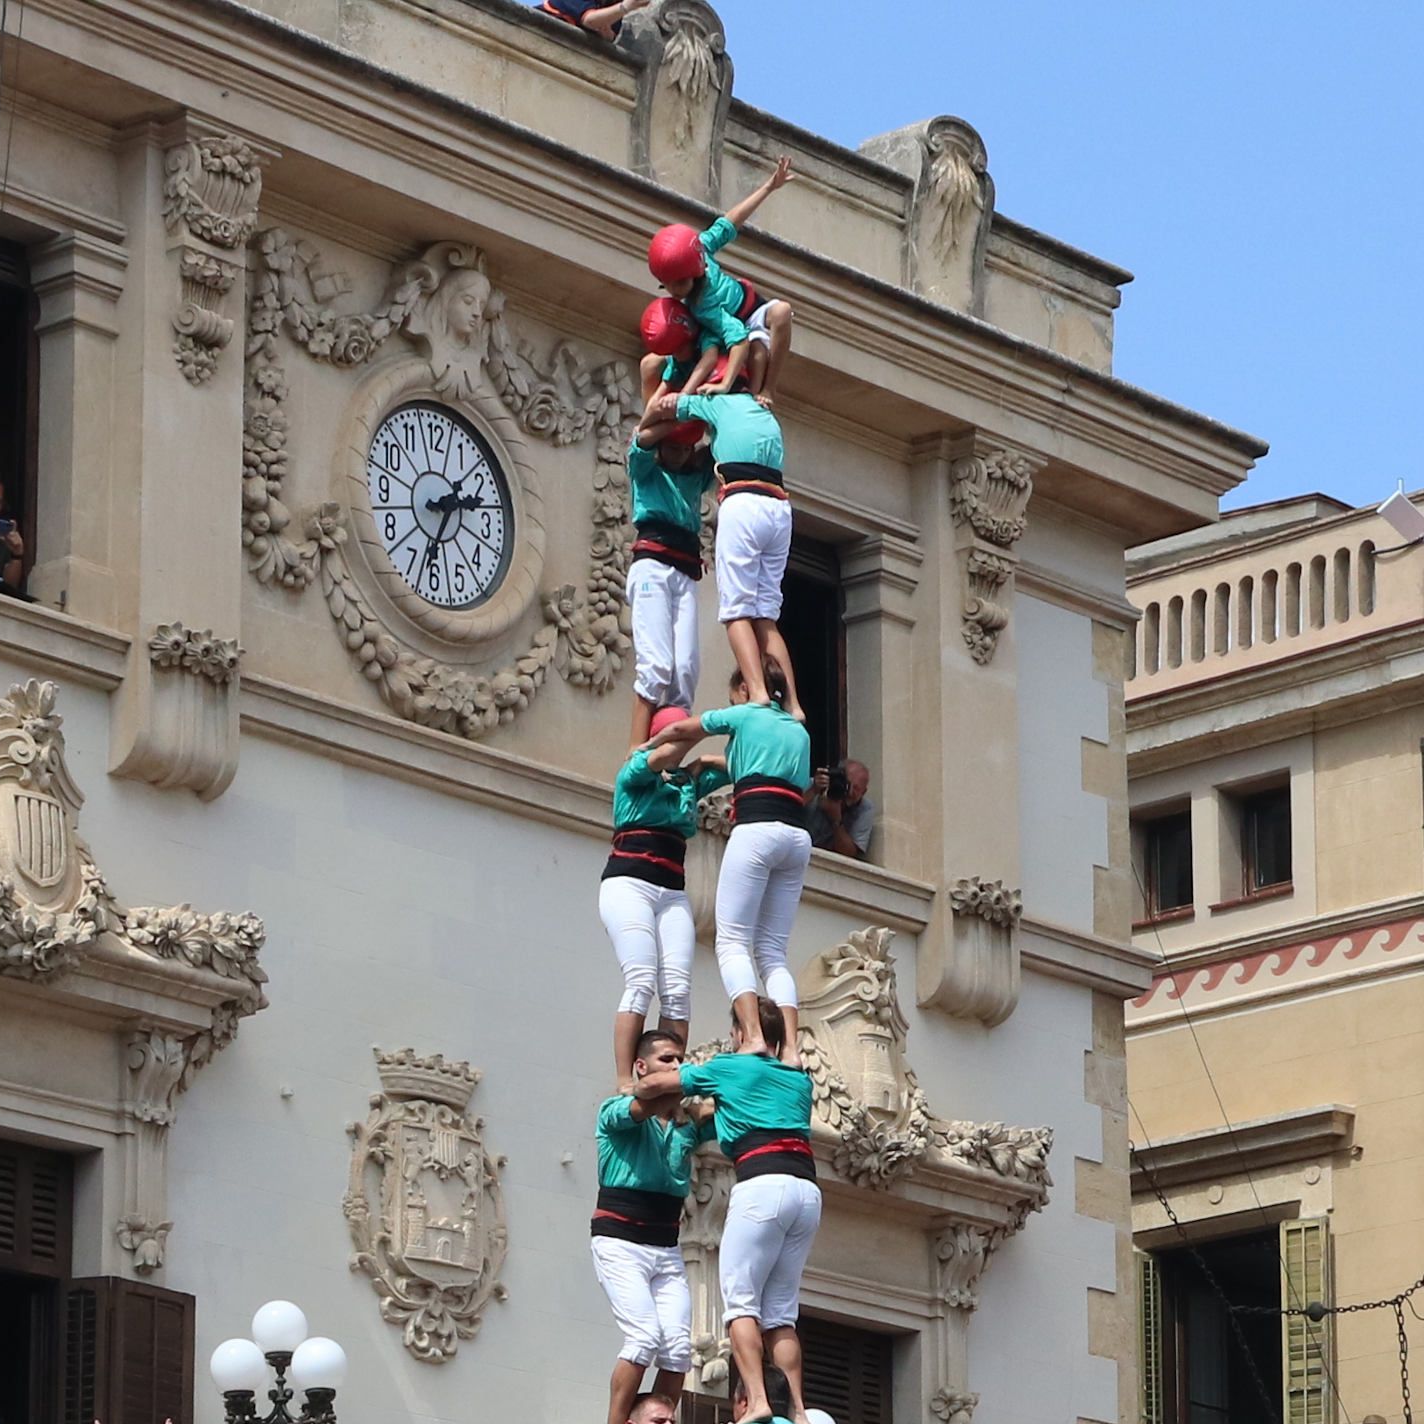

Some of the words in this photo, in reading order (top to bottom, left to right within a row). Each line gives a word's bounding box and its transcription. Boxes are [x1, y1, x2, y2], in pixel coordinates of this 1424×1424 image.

[402, 423, 416, 453] 11
[427, 422, 445, 454] 12
[383, 441, 400, 472] 10
[457, 443, 464, 471] 1
[378, 475, 390, 503] 9
[474, 473, 485, 501] 2
[384, 513, 396, 541] 8
[480, 511, 492, 539] 3
[406, 547, 417, 576] 7
[471, 544, 482, 571] 4
[429, 562, 440, 592] 6
[454, 564, 466, 593] 5
